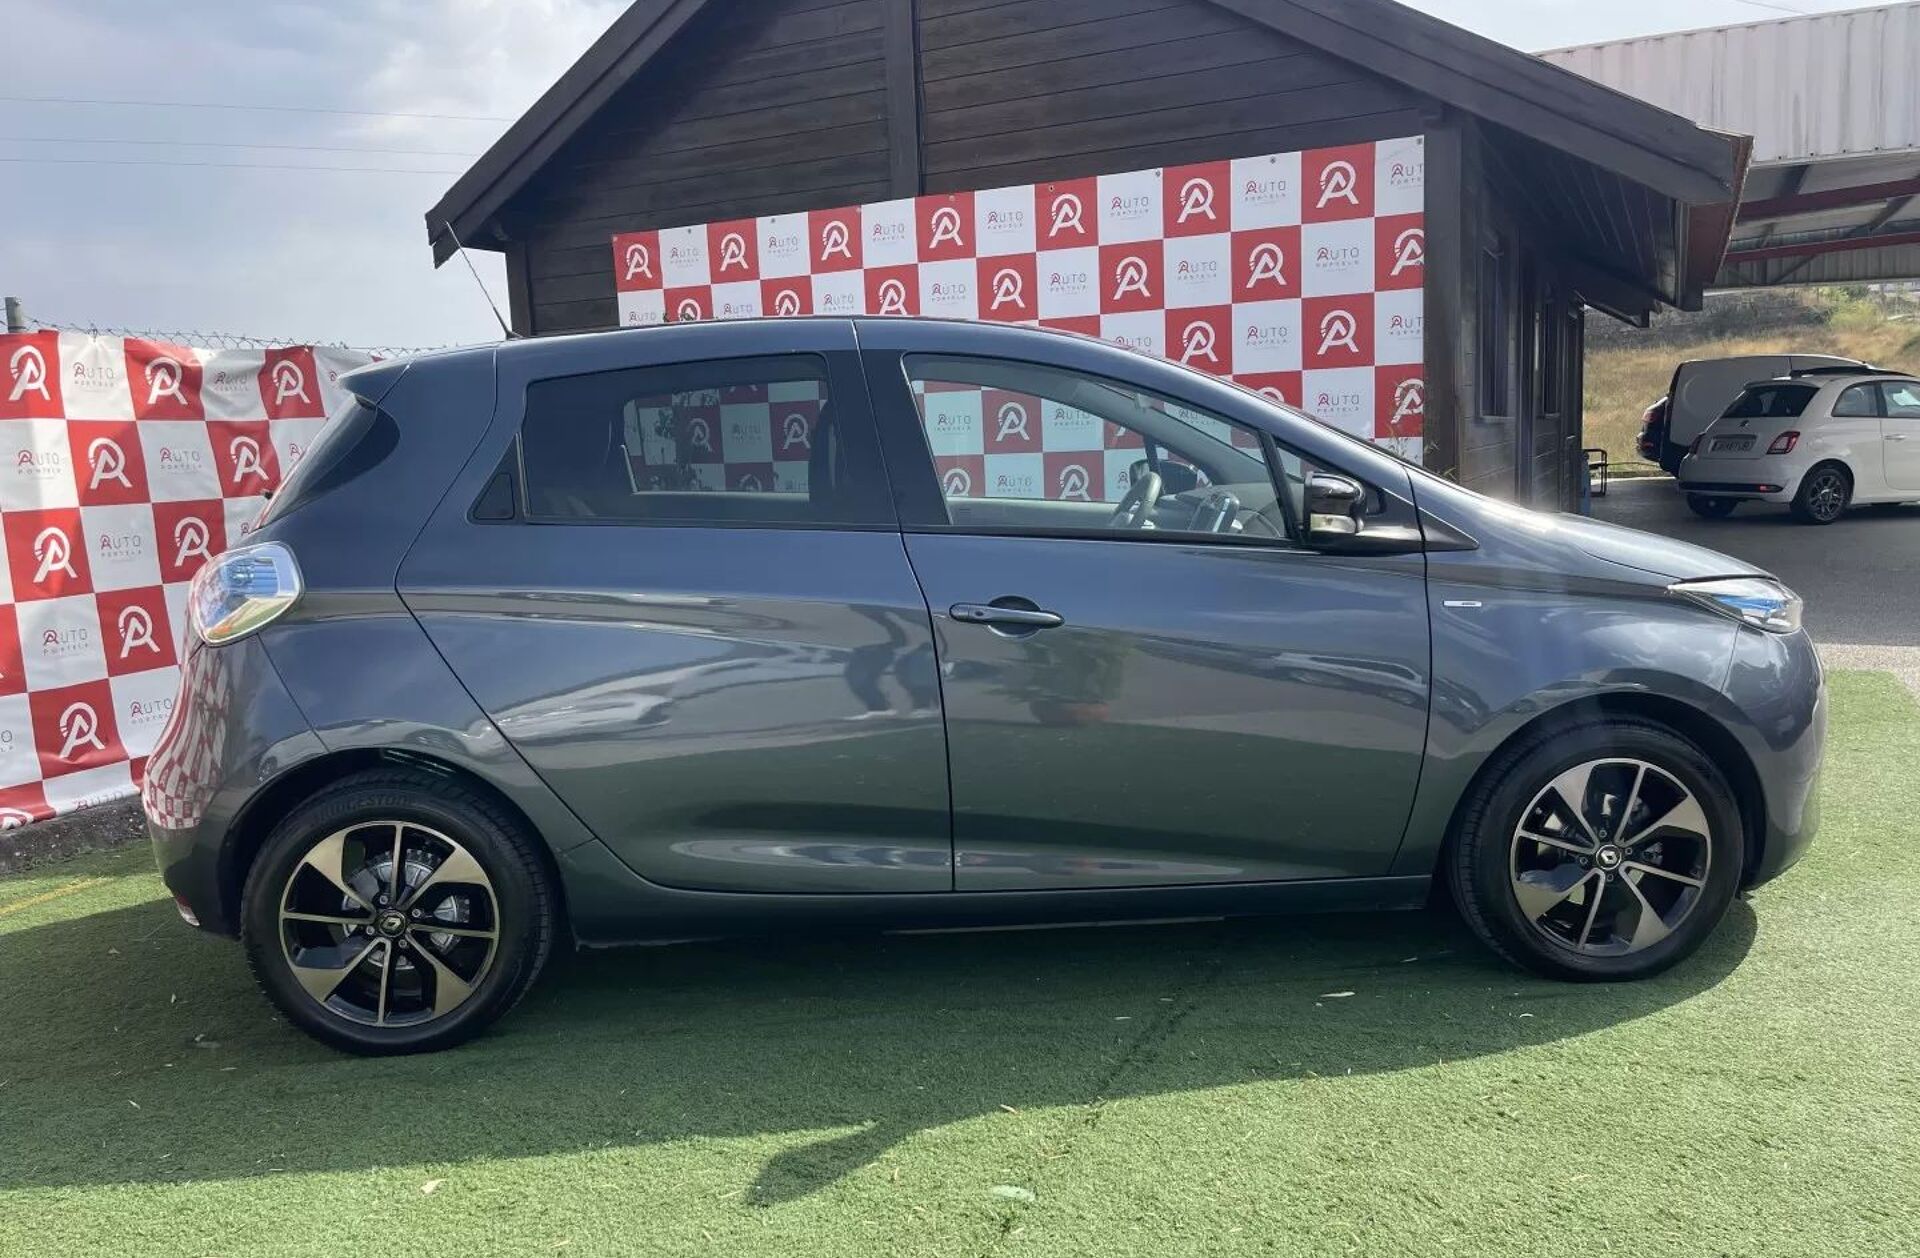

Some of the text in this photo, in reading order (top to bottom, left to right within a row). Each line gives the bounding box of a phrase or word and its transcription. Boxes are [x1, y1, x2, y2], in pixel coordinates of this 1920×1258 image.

[1244, 180, 1286, 194] AUTO
[1112, 196, 1149, 210] AUTO
[988, 211, 1023, 223] AUTO
[873, 224, 904, 236] AUTO
[768, 236, 798, 248] AUTO
[670, 248, 698, 258] AUTO
[1316, 247, 1360, 261] AUTO
[1178, 260, 1217, 274] AUTO
[1050, 272, 1086, 286] AUTO
[932, 283, 966, 295] AUTO
[824, 294, 854, 305] AUTO
[724, 304, 753, 314] AUTO
[1248, 326, 1287, 339] AUTO
[73, 362, 114, 379] AUTO
[1318, 394, 1360, 406] AUTO
[938, 414, 971, 425] AUTO
[18, 450, 59, 466] AUTO
[160, 448, 200, 462] AUTO
[997, 475, 1032, 487] AUTO
[100, 535, 141, 550] AUTO
[43, 629, 88, 646] AUTO
[130, 698, 172, 717] AUTO
